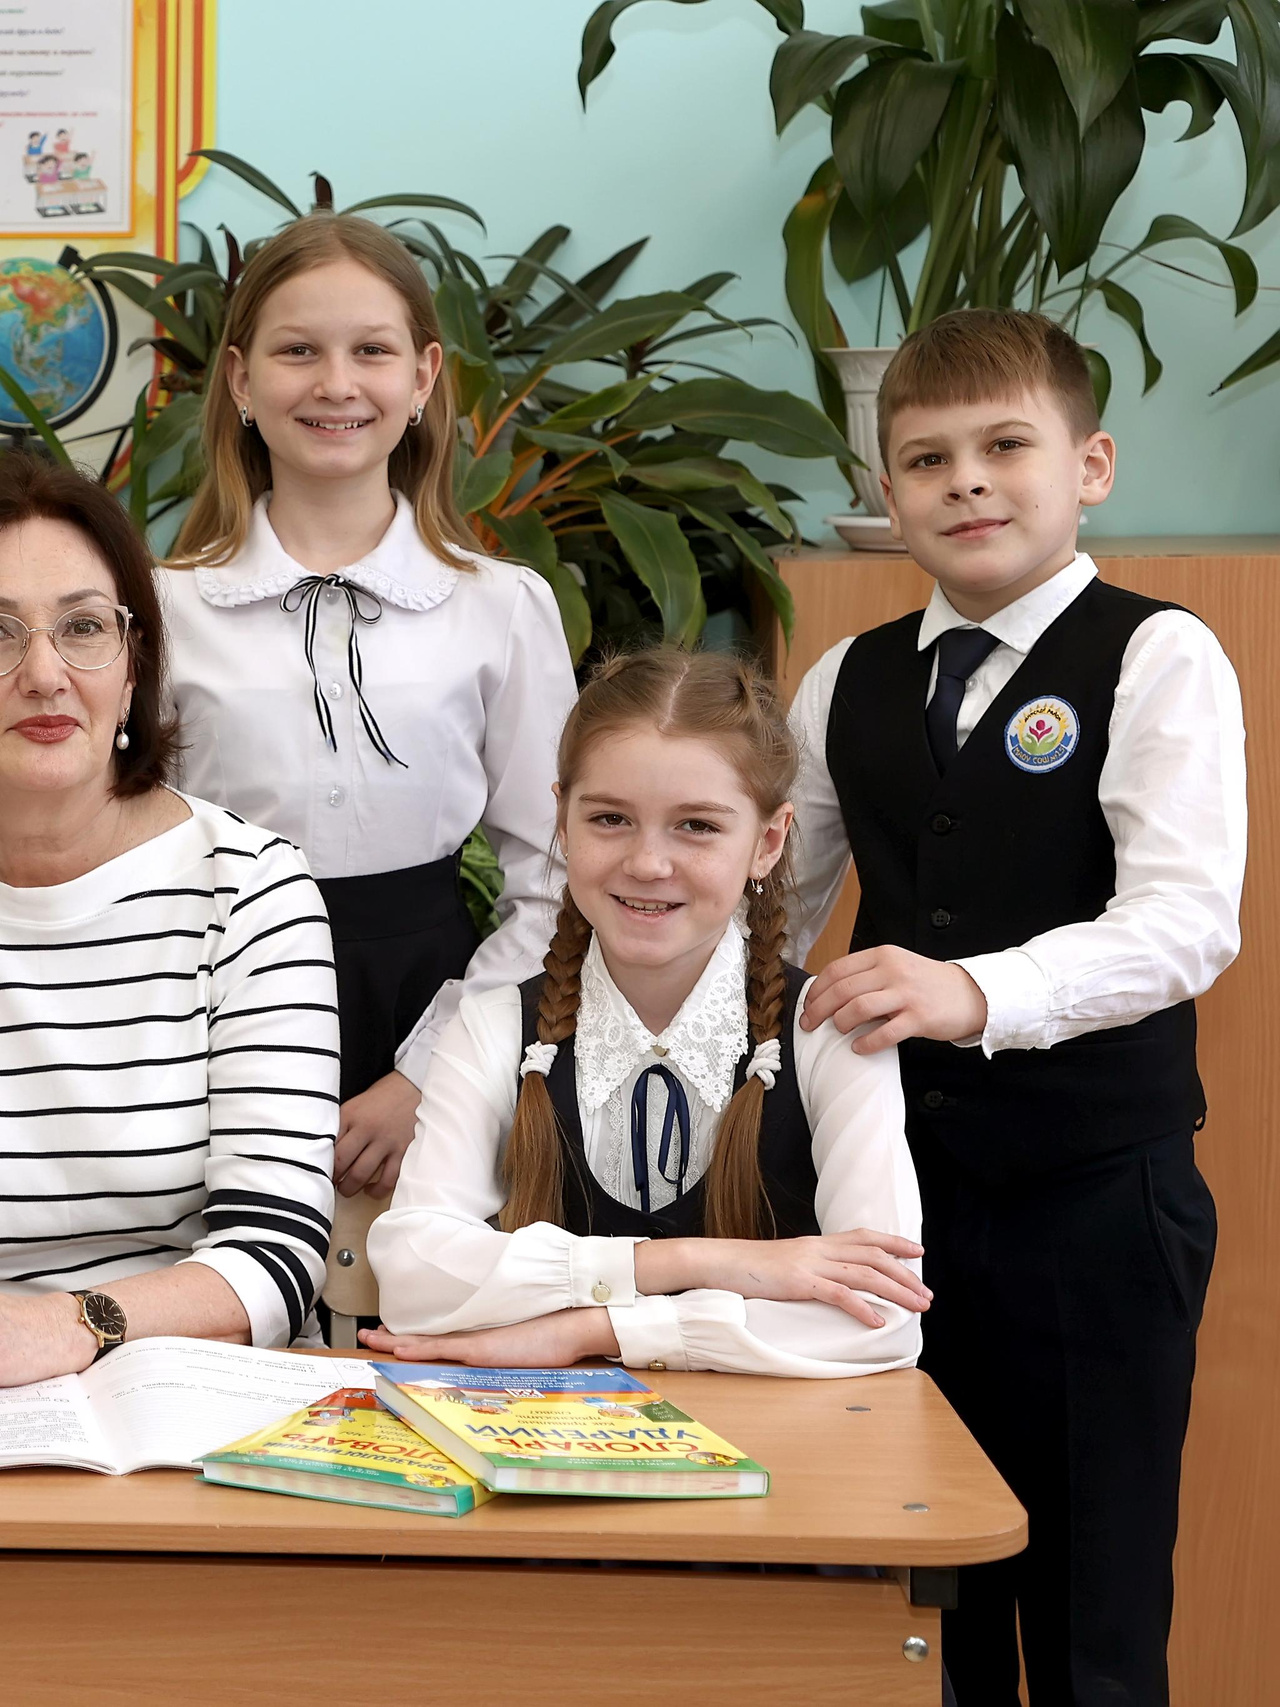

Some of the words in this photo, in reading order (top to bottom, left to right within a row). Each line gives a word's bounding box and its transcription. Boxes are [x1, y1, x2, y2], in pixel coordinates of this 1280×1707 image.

[465, 1424, 702, 1440] УДАРЕНИЙ
[282, 1433, 453, 1464] СЛОВАРЬ
[495, 1438, 699, 1452] СЛОВАРЬ
[263, 1442, 447, 1472] ФРАЗЕОЛОГИЧЕСКИЙ
